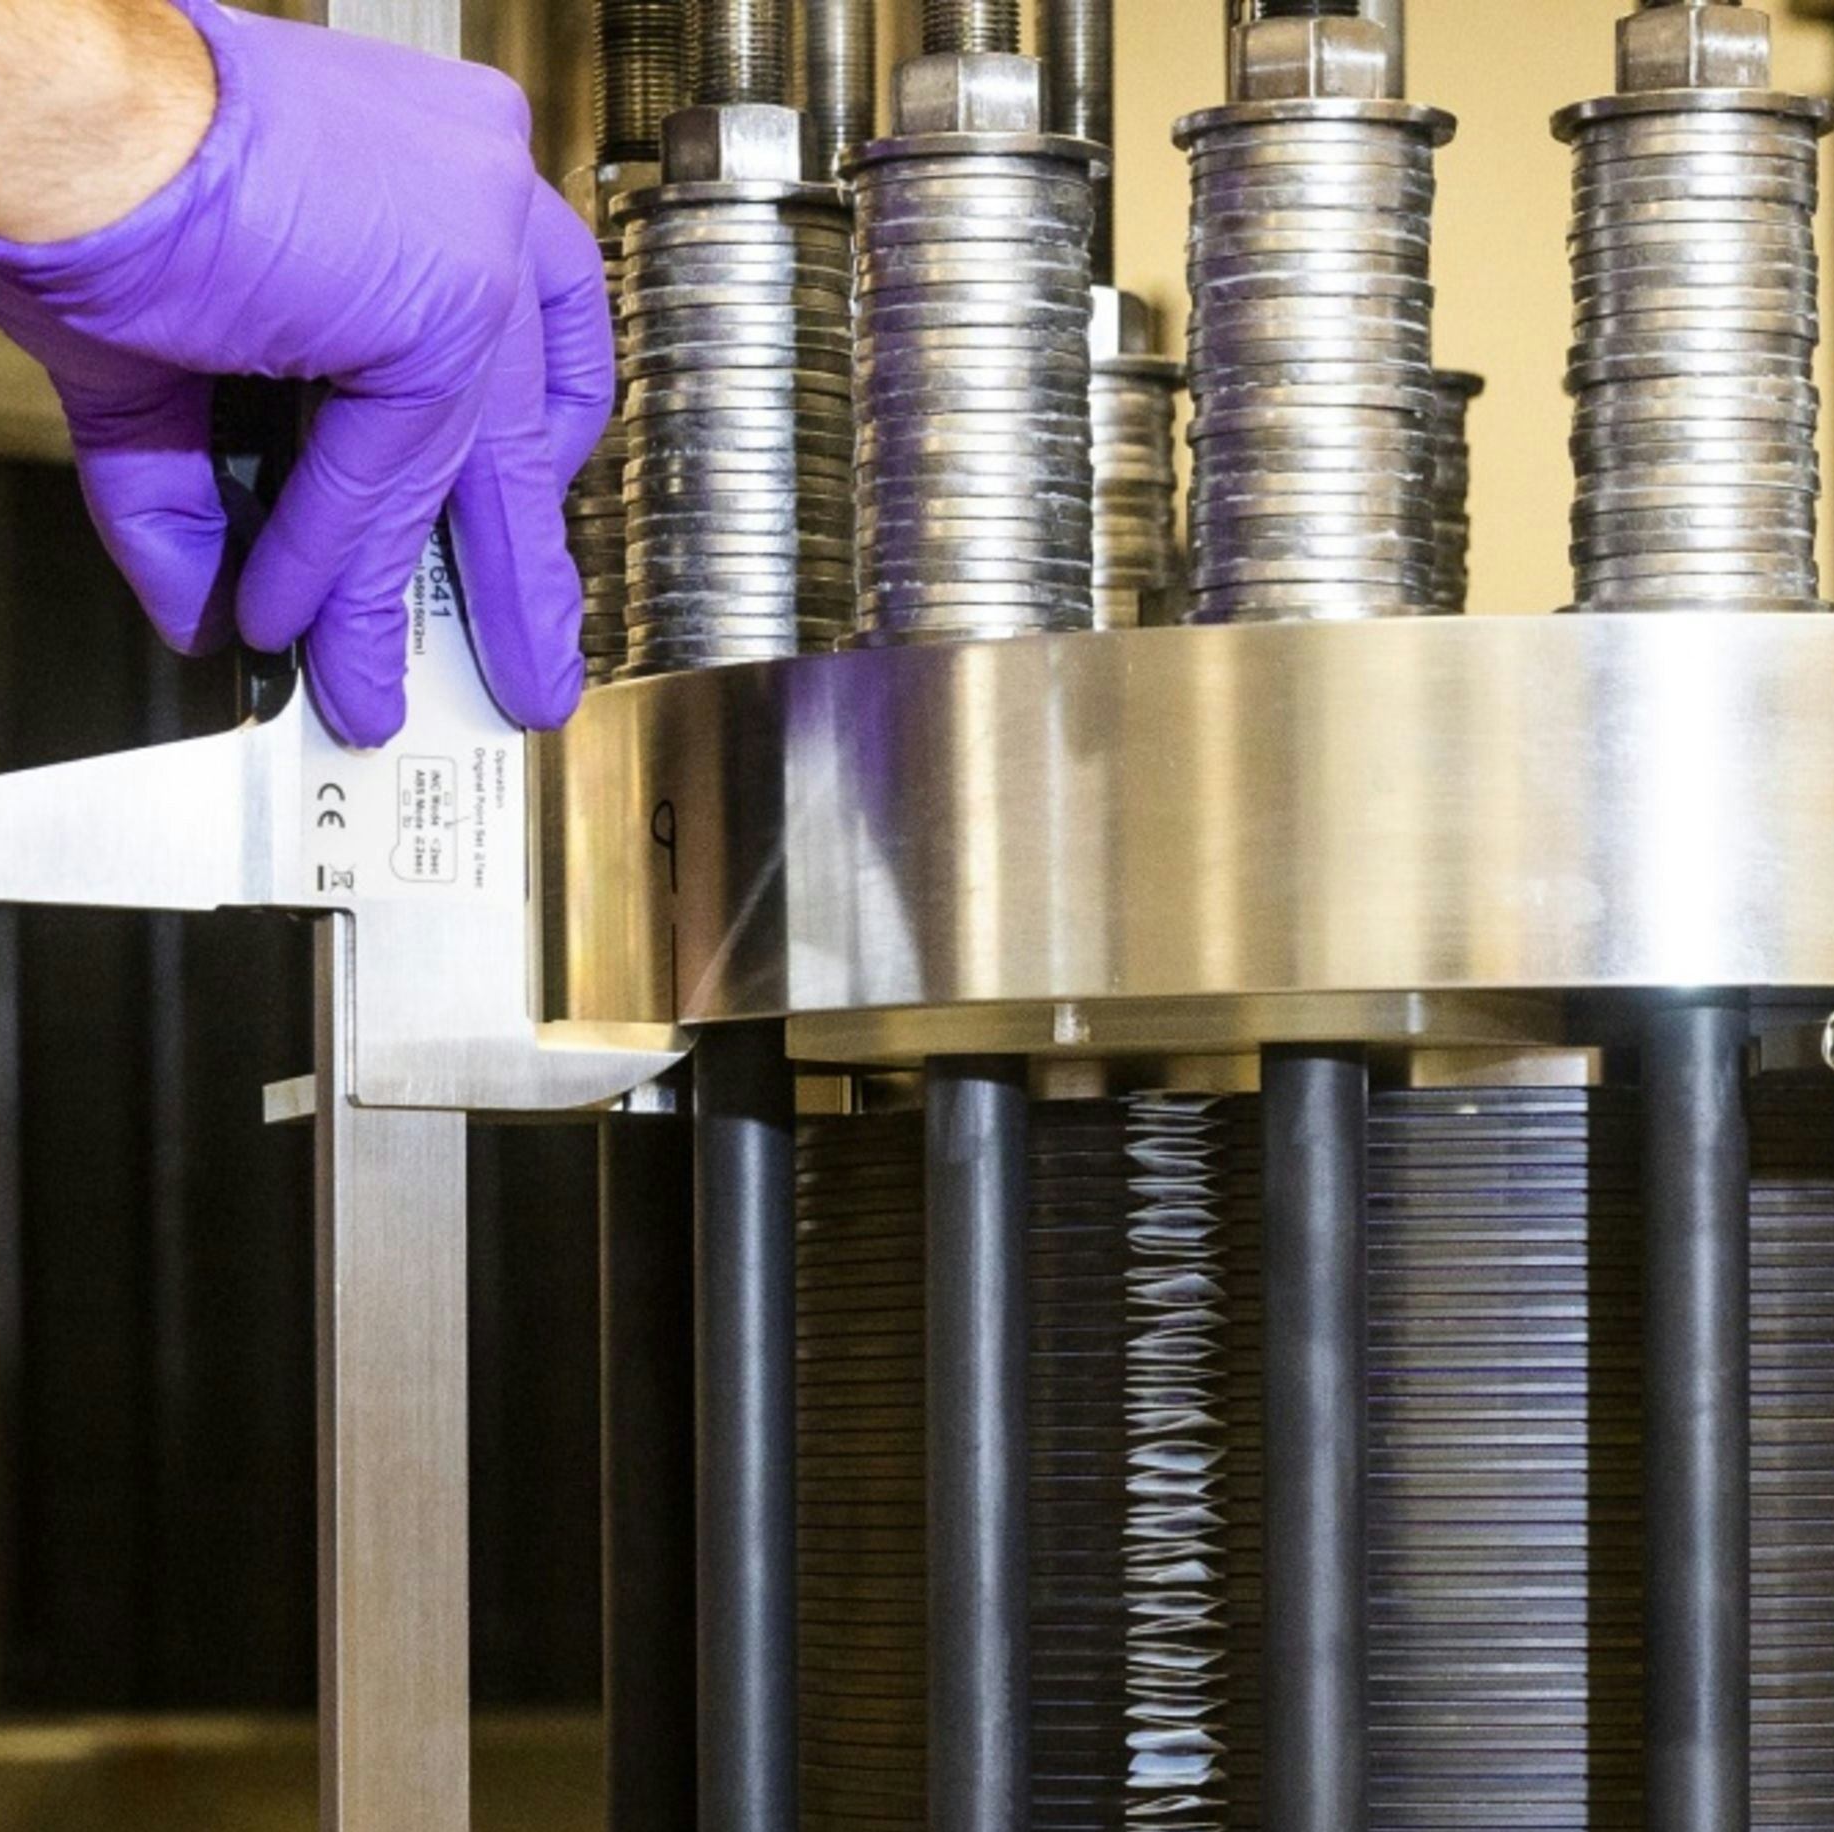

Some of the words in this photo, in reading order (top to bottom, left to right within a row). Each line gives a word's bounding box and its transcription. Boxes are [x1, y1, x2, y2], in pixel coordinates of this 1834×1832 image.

[415, 769, 426, 795] ABS
[472, 747, 486, 793] Original
[495, 748, 507, 810] Operation
[415, 798, 426, 830] Mode
[430, 795, 442, 827] Mode
[473, 796, 486, 826] Point
[474, 829, 486, 848] Set
